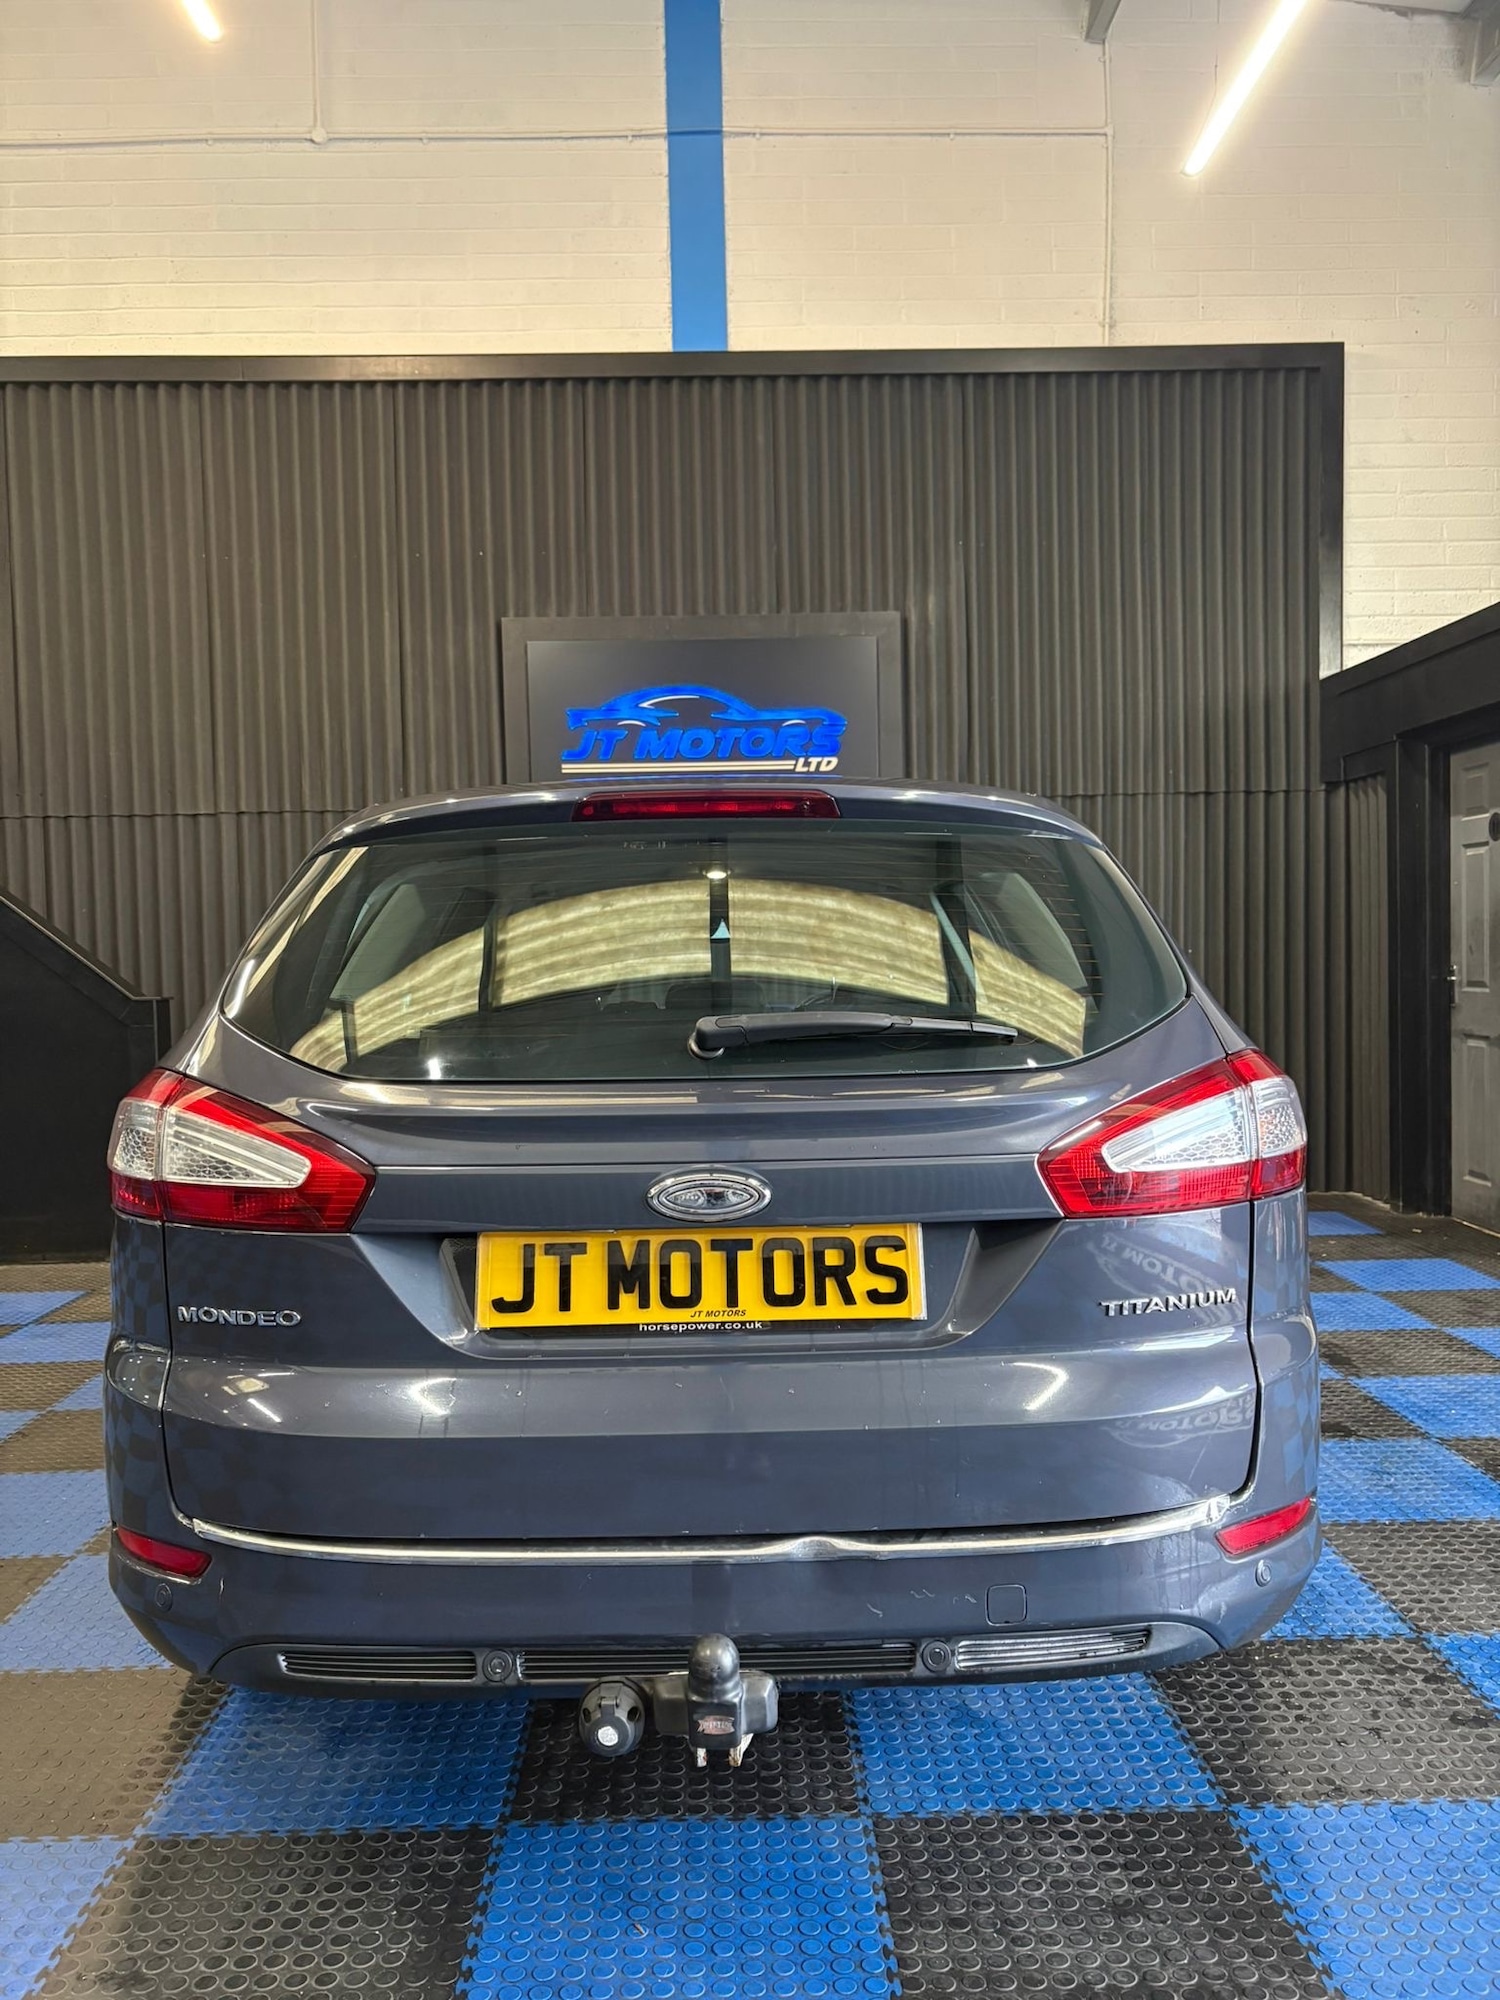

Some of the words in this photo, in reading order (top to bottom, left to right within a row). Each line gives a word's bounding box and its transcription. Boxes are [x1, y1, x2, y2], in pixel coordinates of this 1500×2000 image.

[561, 729, 629, 761] JT
[634, 724, 846, 760] MOTORS
[794, 756, 838, 773] LTD
[491, 1242, 588, 1313] JT
[607, 1235, 909, 1309] MOTORS
[1100, 1288, 1236, 1316] TITANIUM
[177, 1306, 301, 1327] MONDEO
[705, 1309, 746, 1318] MOTORS
[638, 1321, 763, 1333] horsepower.co.uk
